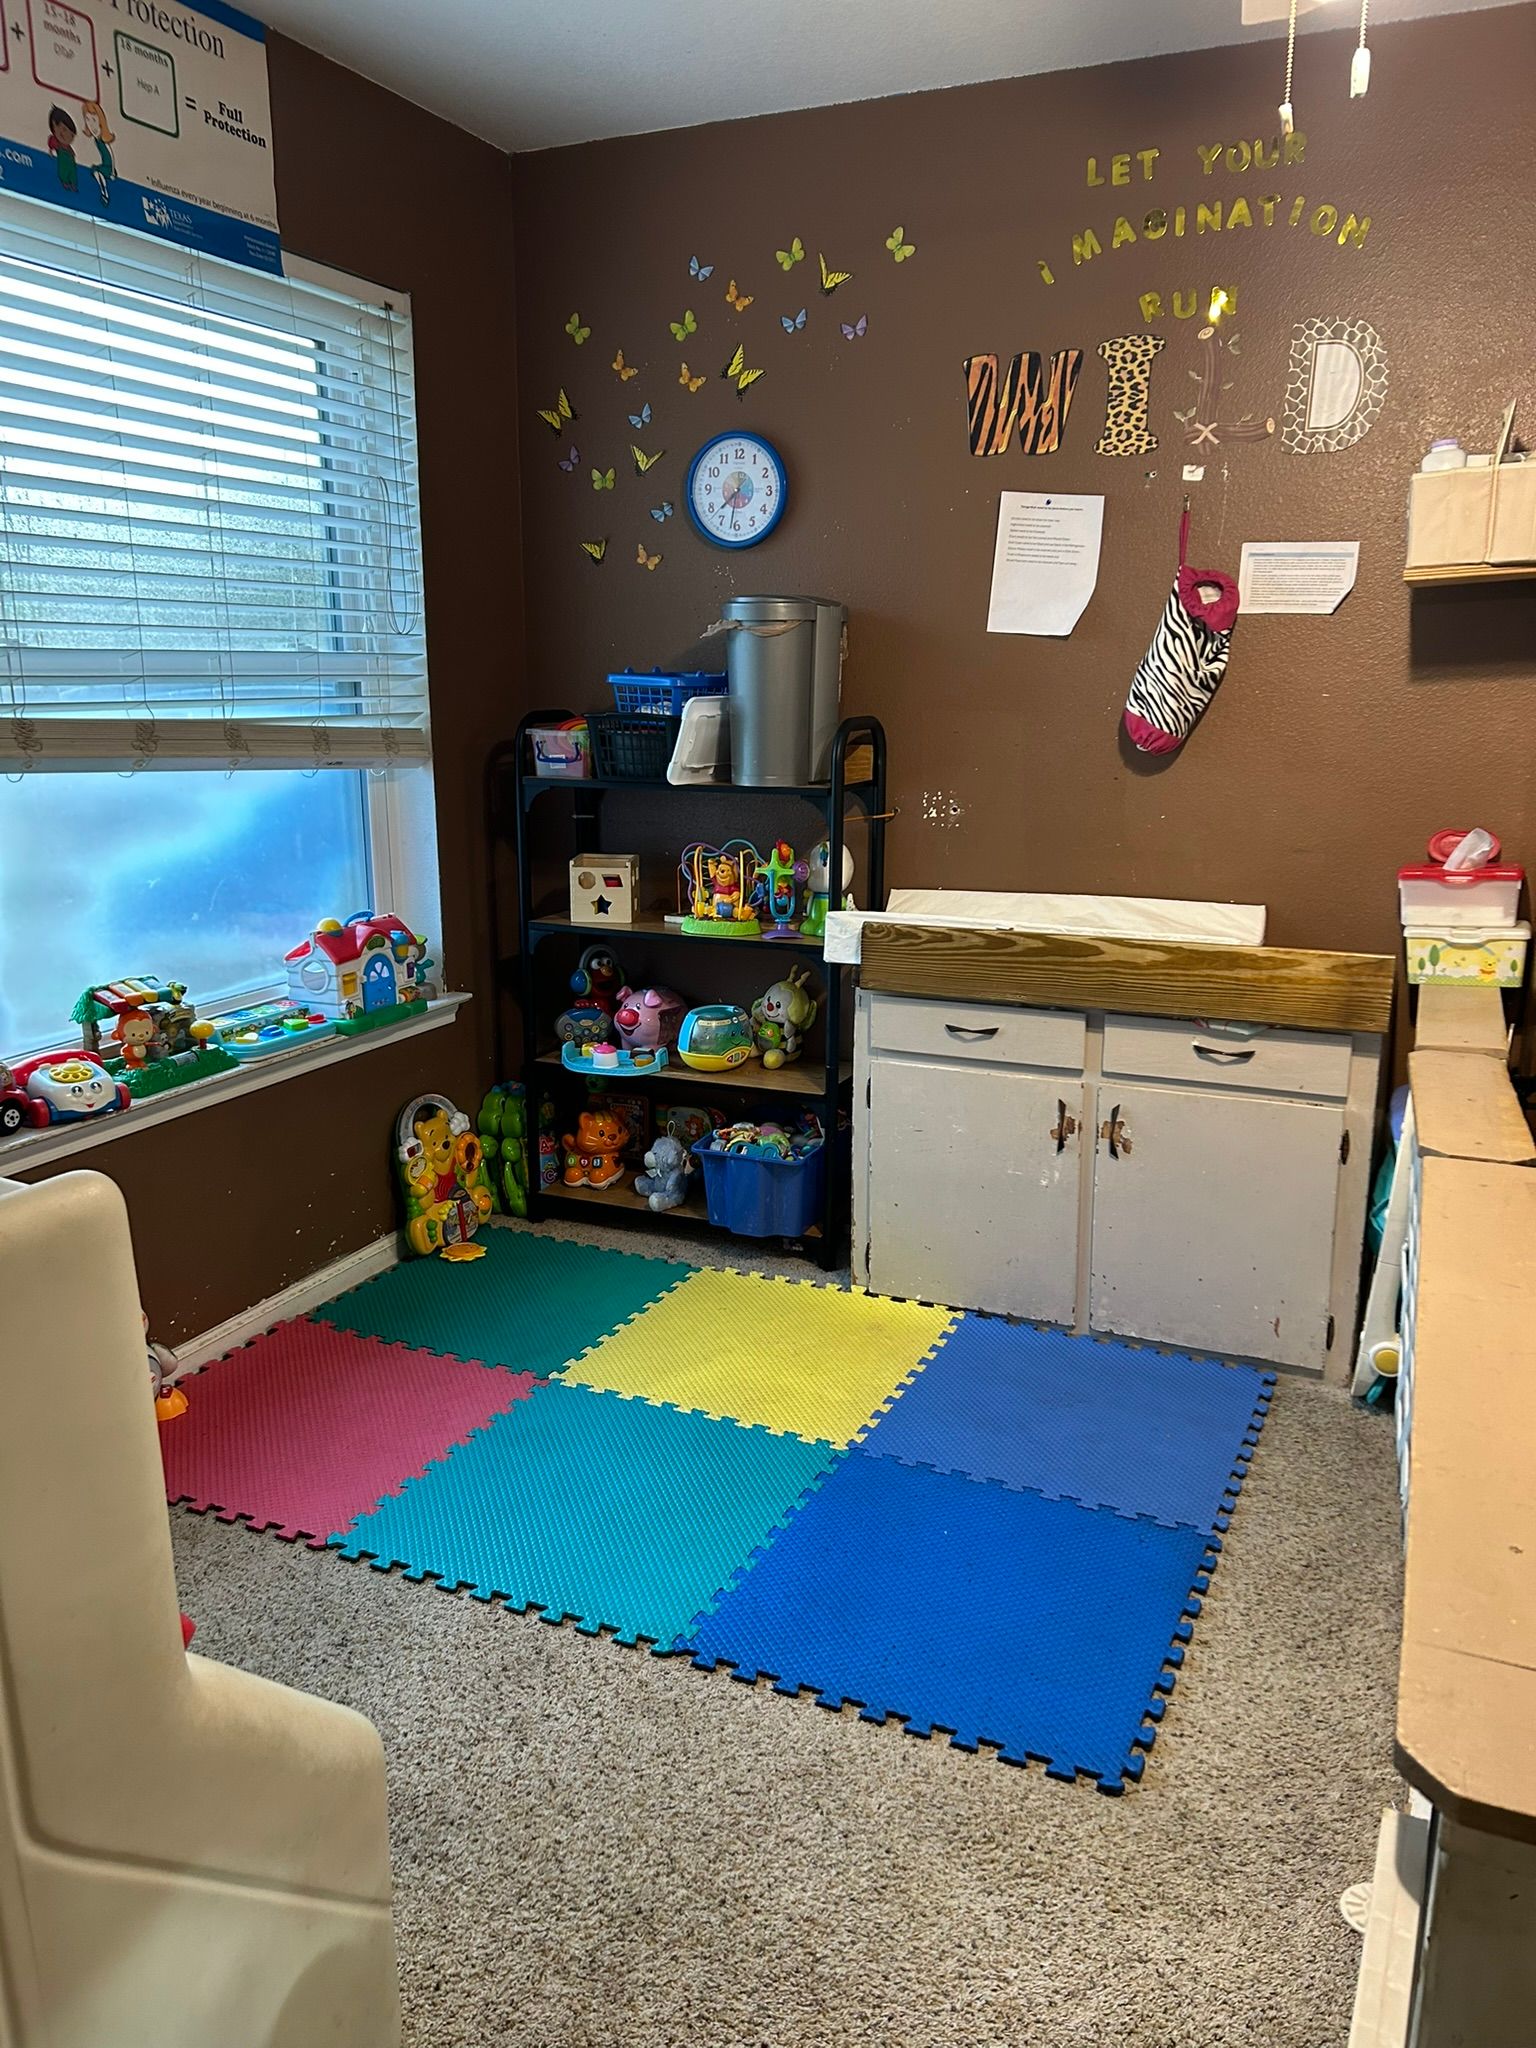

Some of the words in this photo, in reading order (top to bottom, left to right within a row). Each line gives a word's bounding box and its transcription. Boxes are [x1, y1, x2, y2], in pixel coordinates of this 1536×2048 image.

[43, 19, 82, 46] months
[134, 44, 169, 69] months
[153, 85, 160, 97] A
[218, 100, 243, 125] Full
[203, 109, 267, 149] Protection
[1087, 148, 1160, 188] LET
[1198, 131, 1307, 176] YOUR
[151, 177, 180, 195] Influenza
[181, 189, 198, 202] every
[212, 200, 243, 219] beginning
[1138, 285, 1241, 325] RUN
[962, 315, 1391, 458] WILD
[719, 453, 729, 464] 11
[734, 448, 745, 460] 12
[752, 454, 757, 465] 1
[708, 466, 720, 478] 10
[761, 467, 769, 479] 2
[704, 483, 712, 495] 9
[765, 485, 773, 496] 3
[707, 502, 715, 513] 8
[759, 504, 768, 515] 4
[718, 515, 725, 526] 7
[732, 519, 741, 531] 6
[748, 516, 756, 527] 5
